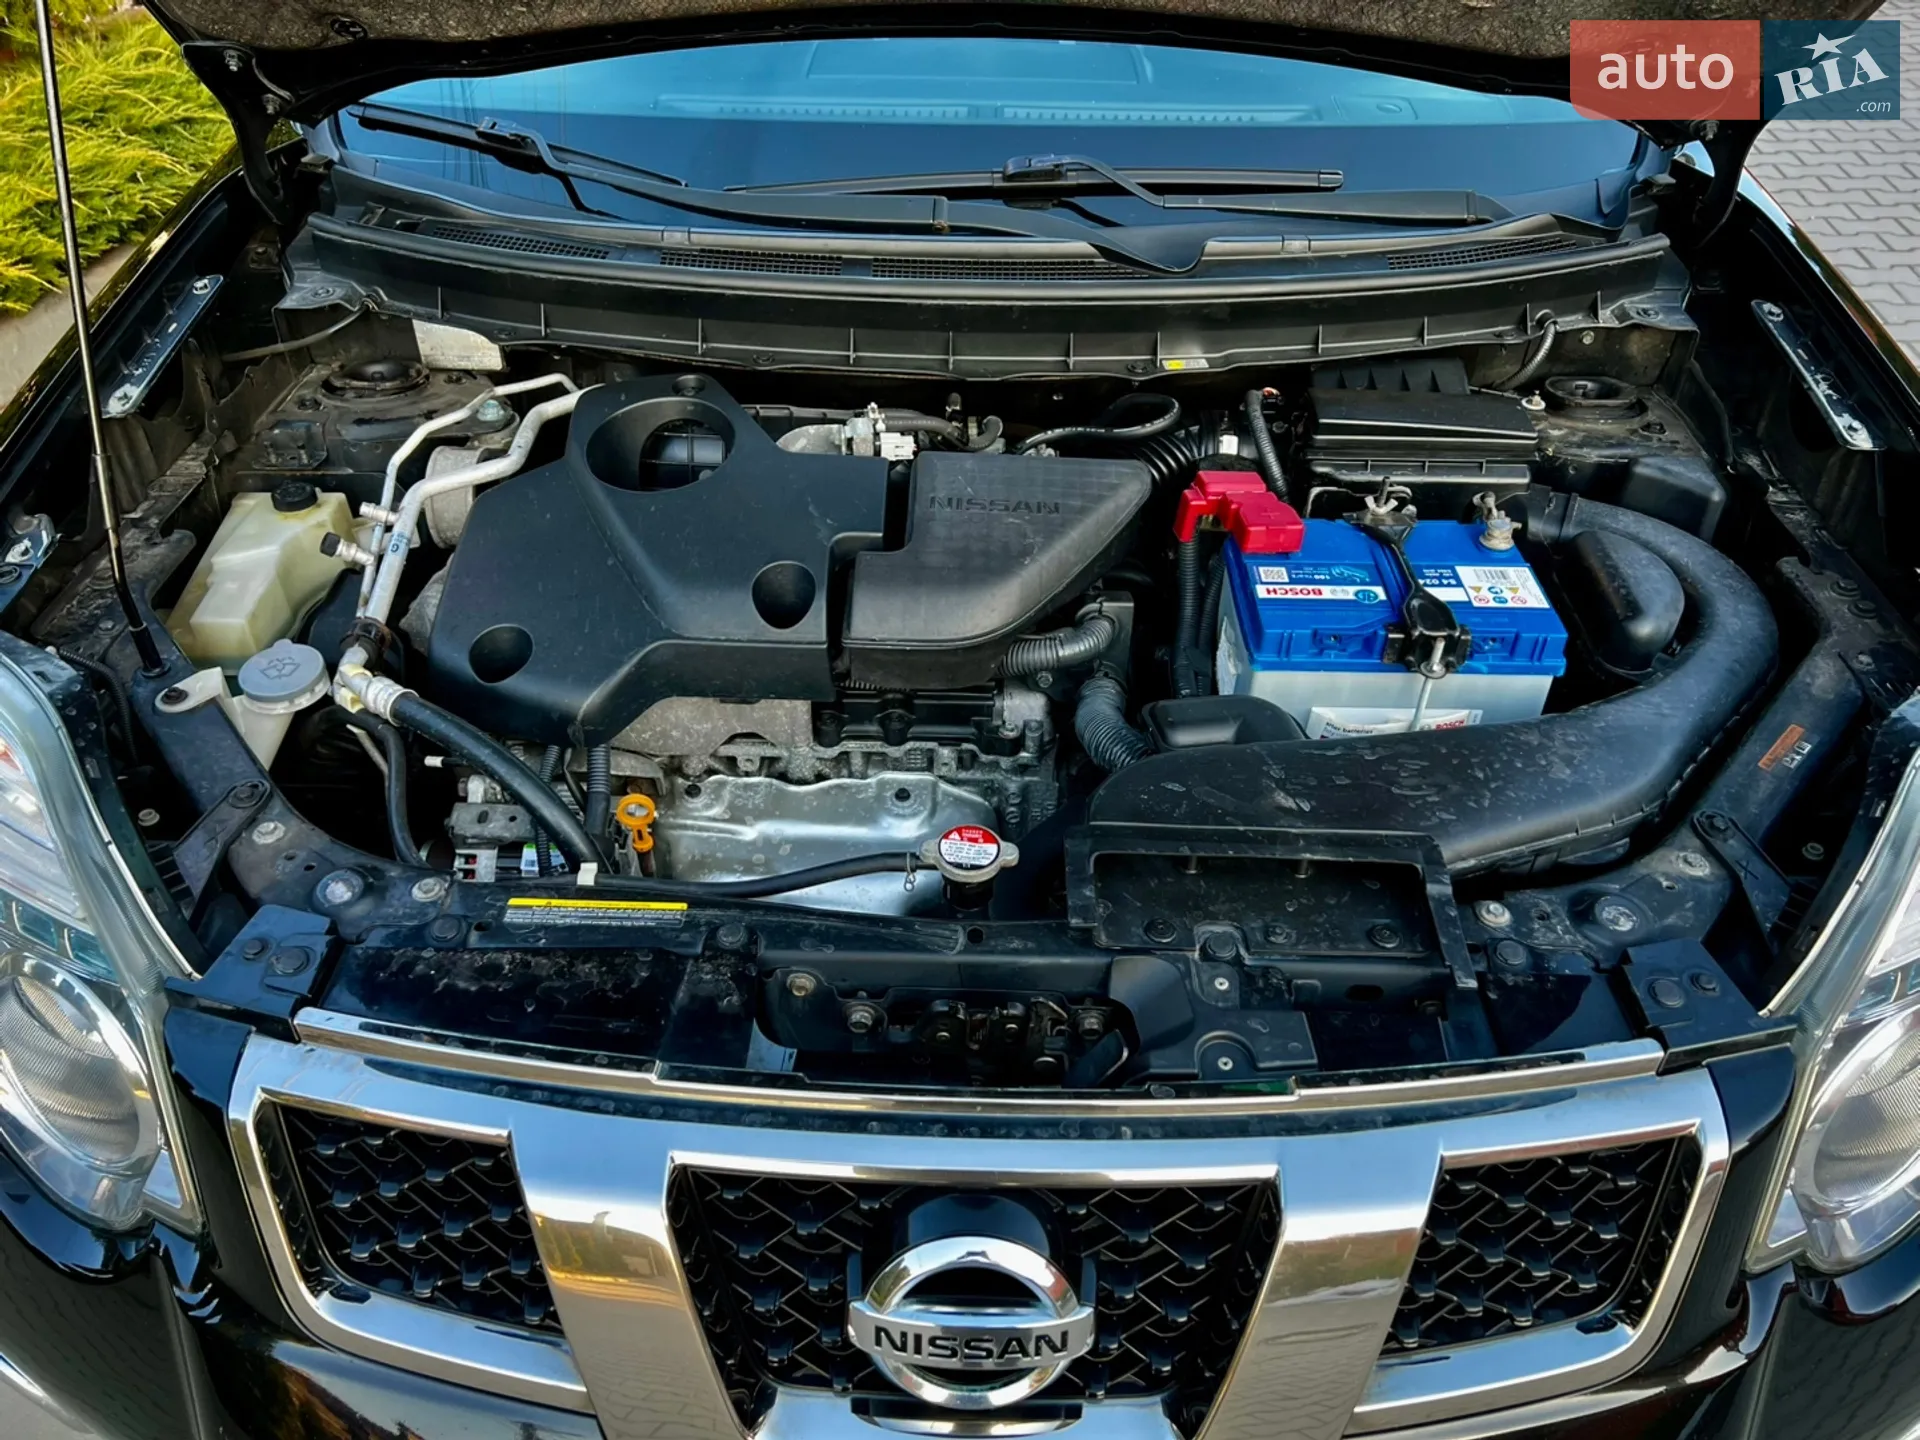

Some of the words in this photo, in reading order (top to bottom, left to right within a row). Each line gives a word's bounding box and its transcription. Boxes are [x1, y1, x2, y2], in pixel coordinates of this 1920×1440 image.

[929, 496, 1061, 514] NISSAN
[1265, 587, 1323, 597] BOSCH
[873, 1324, 1069, 1362] NISSAN
